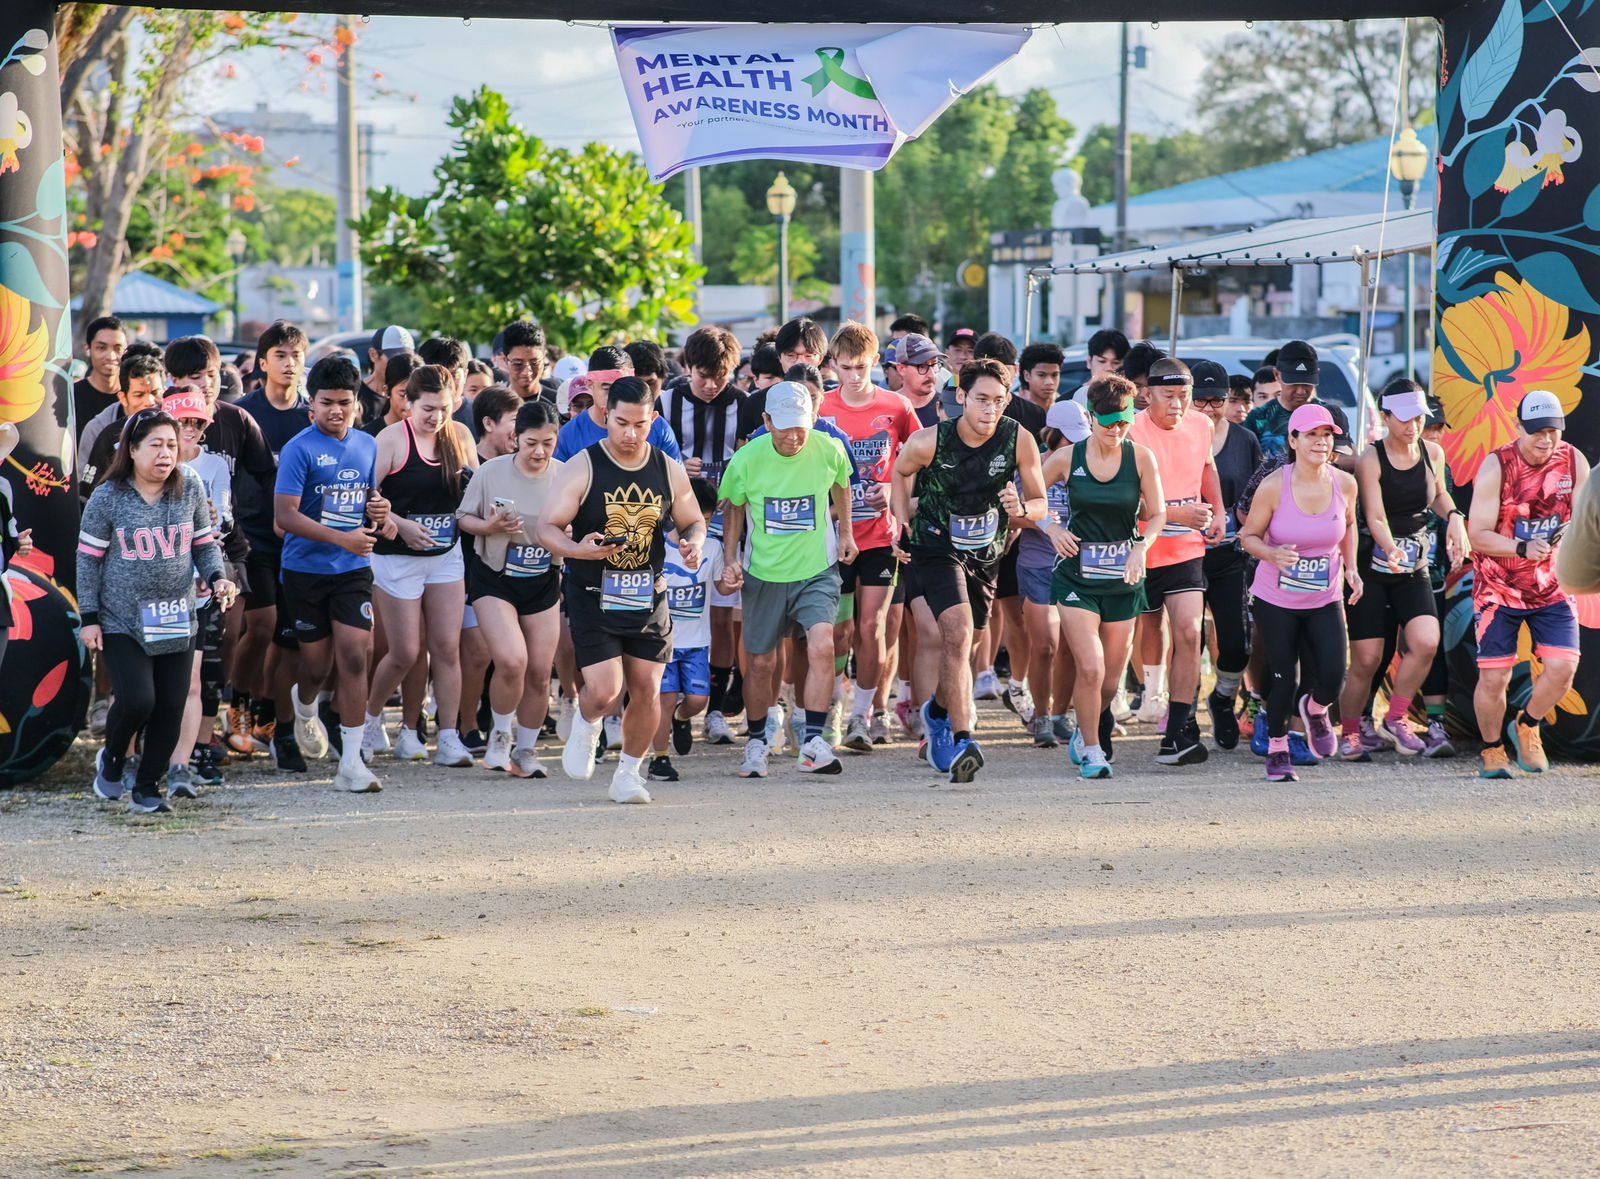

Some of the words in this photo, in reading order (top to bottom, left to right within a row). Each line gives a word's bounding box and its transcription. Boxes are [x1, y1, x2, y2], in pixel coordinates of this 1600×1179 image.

[636, 53, 794, 75] MENTAL
[643, 70, 793, 103] HEALTH
[653, 96, 800, 125] AWARENESS
[808, 106, 889, 133] MONTH
[854, 441, 869, 449] OF
[331, 490, 363, 505] 1910
[772, 498, 810, 513] 1873
[958, 513, 995, 531] 1719
[1522, 515, 1559, 533] 1746
[116, 522, 193, 560] LOVE
[1089, 541, 1127, 559] 1704
[611, 573, 650, 588] 1803
[666, 585, 703, 601] 1872
[148, 598, 188, 617] 1868
